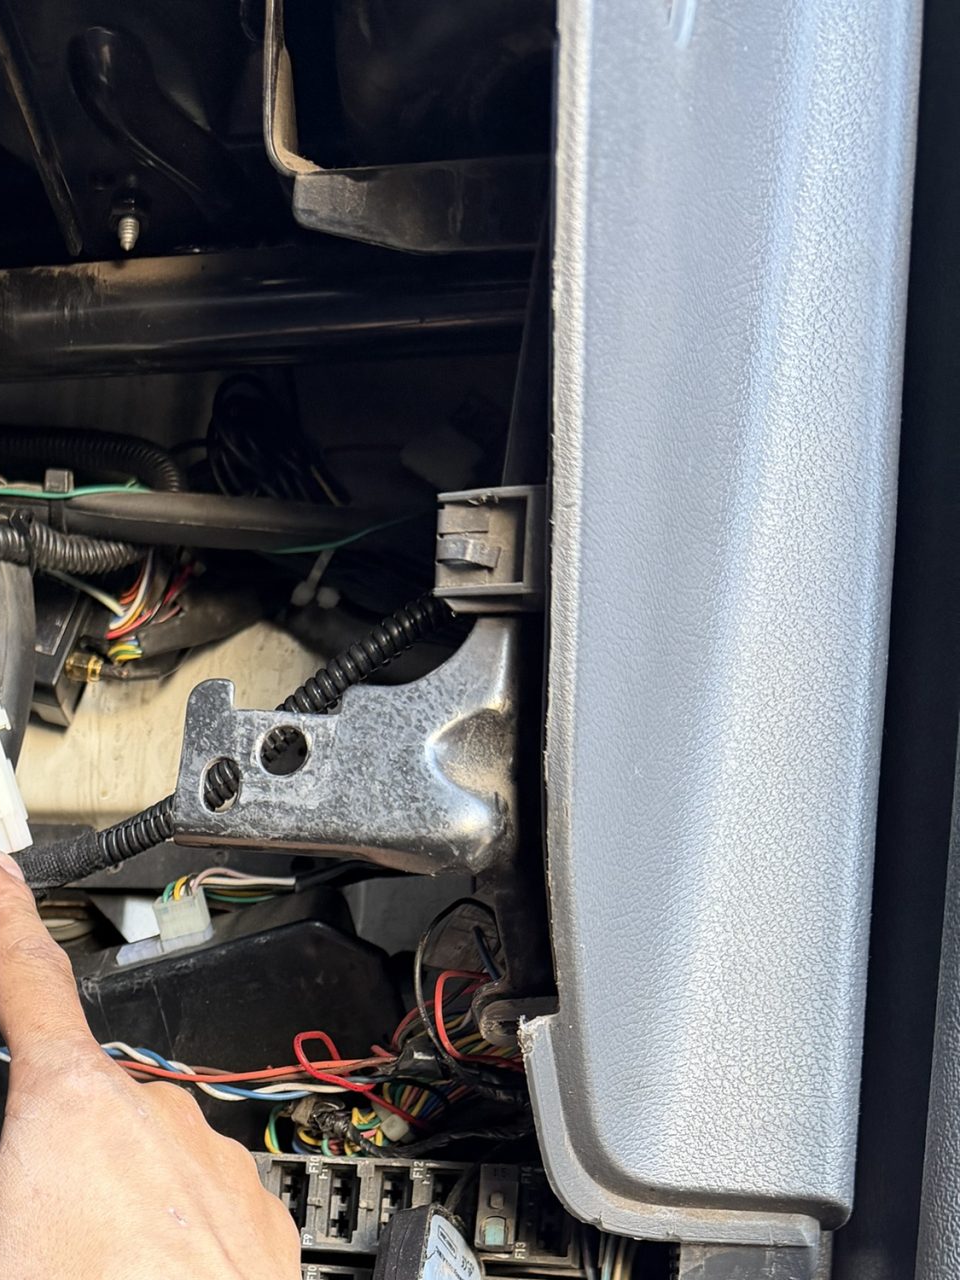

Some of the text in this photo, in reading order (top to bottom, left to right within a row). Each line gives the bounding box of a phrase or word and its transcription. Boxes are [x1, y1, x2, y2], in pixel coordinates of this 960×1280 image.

[309, 1156, 321, 1173] F10
[412, 1161, 424, 1179] F12
[302, 1233, 313, 1246] F9
[513, 1241, 525, 1260] F13
